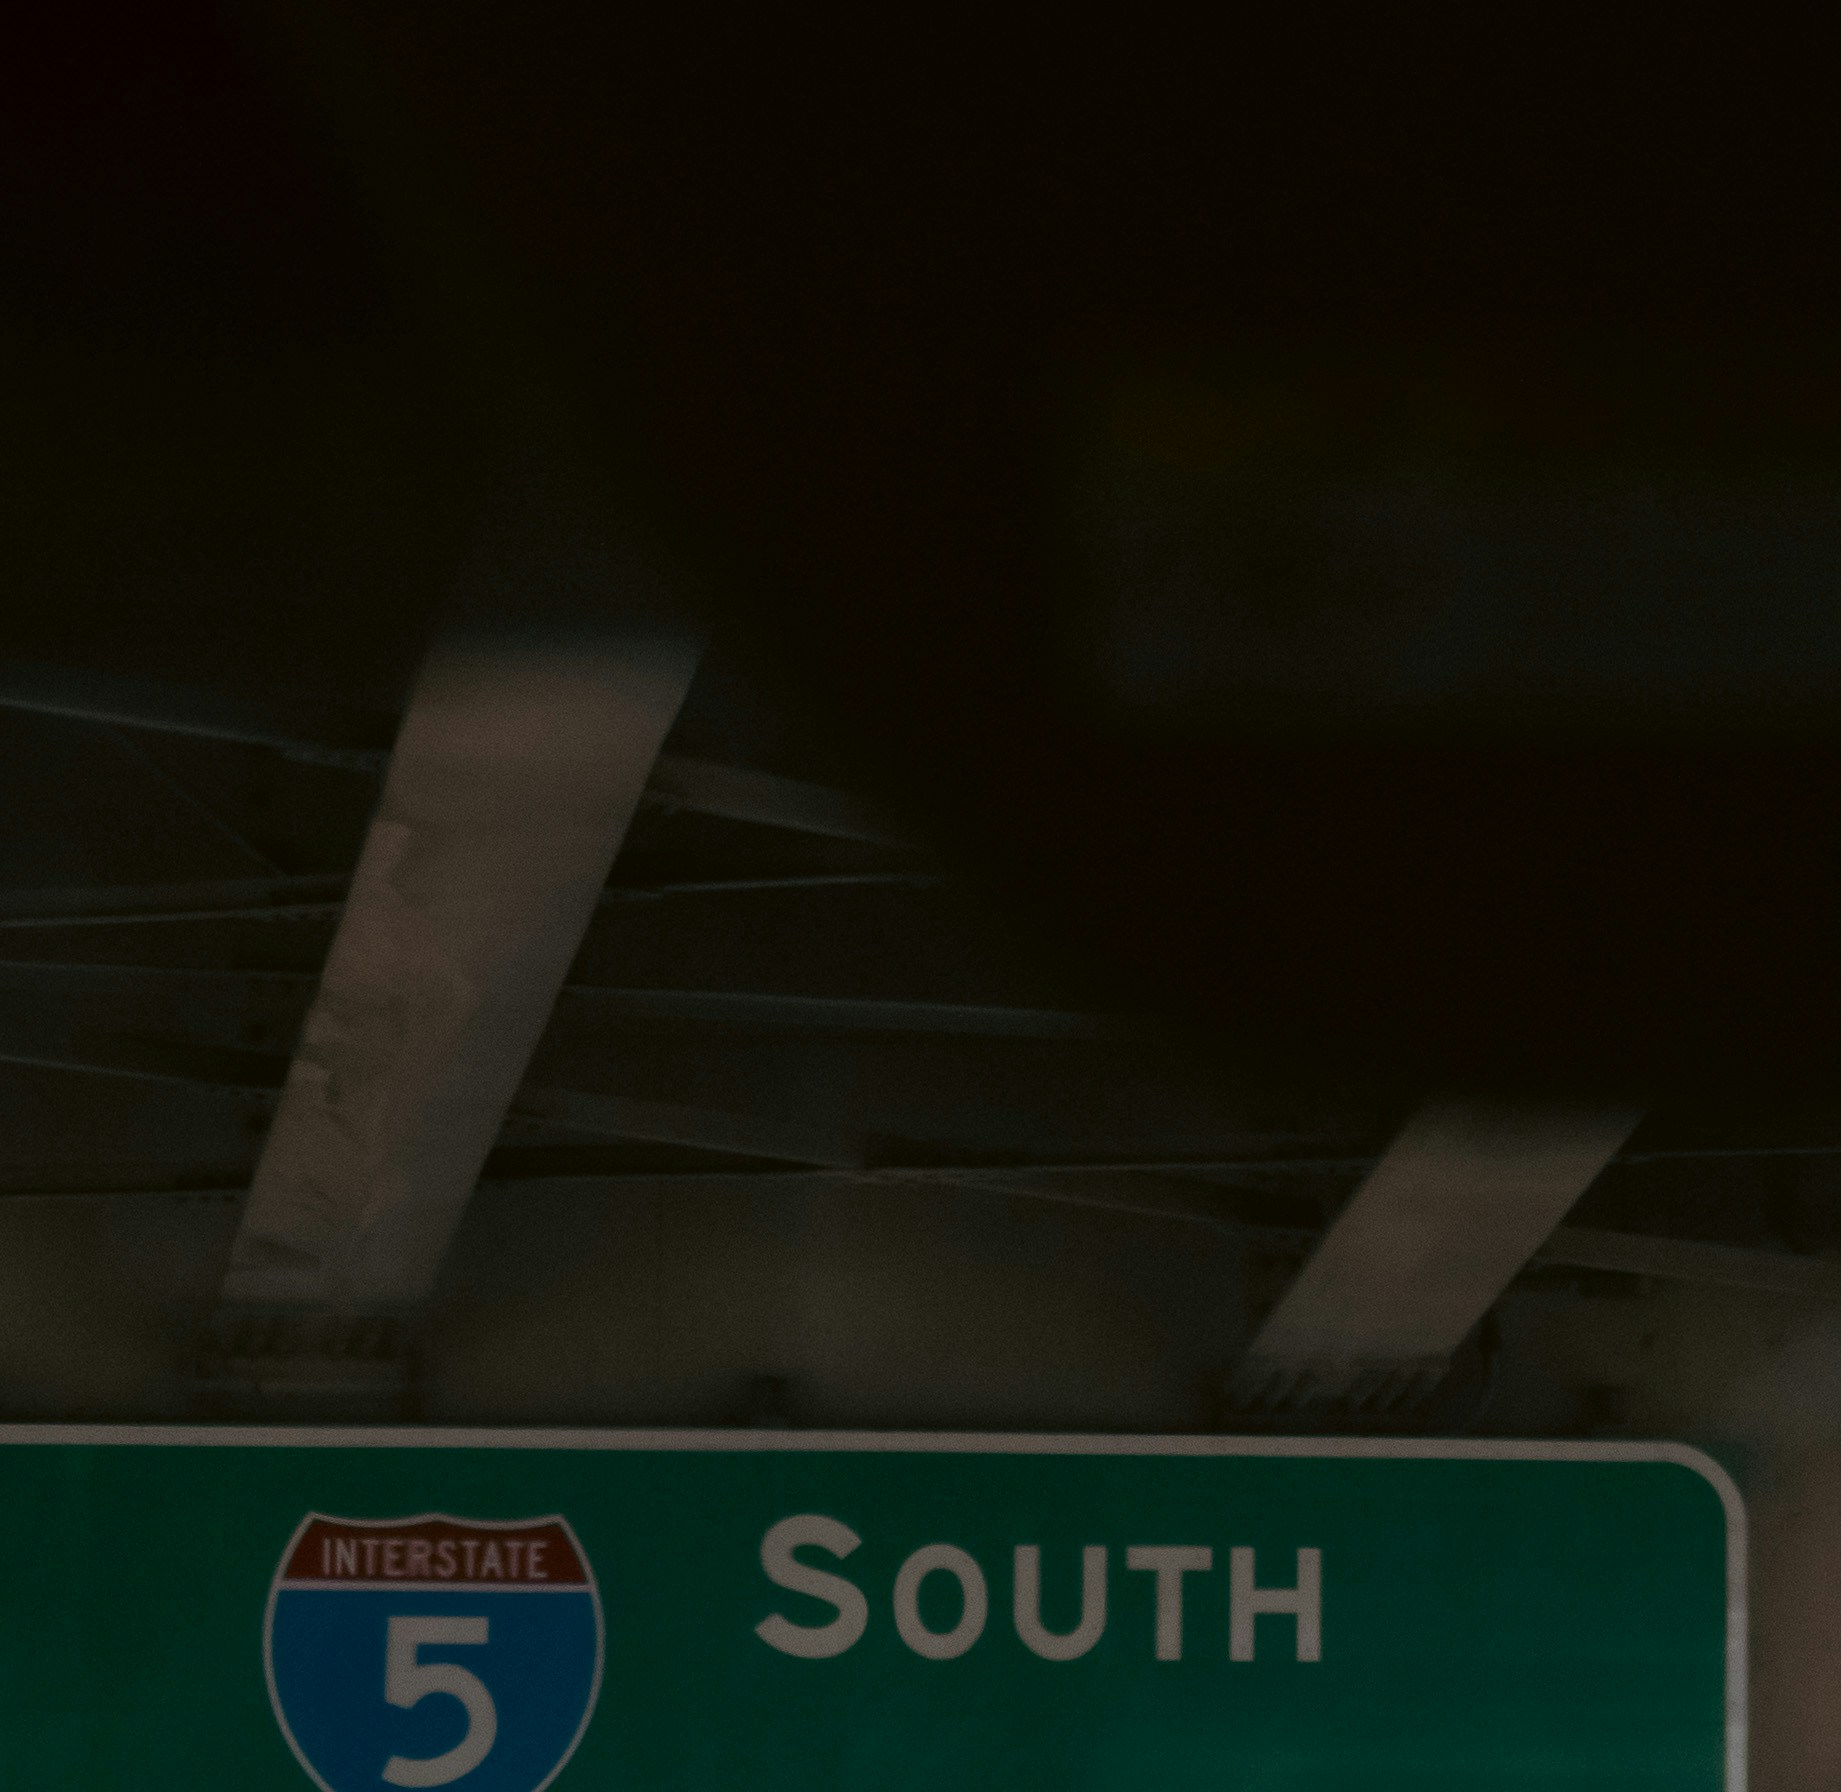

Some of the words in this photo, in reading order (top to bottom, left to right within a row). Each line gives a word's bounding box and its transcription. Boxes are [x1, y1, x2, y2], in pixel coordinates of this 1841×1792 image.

[321, 1537, 550, 1580] INTERSTATE
[754, 1513, 1322, 1662] SOUTH
[381, 1615, 499, 1789] 5
